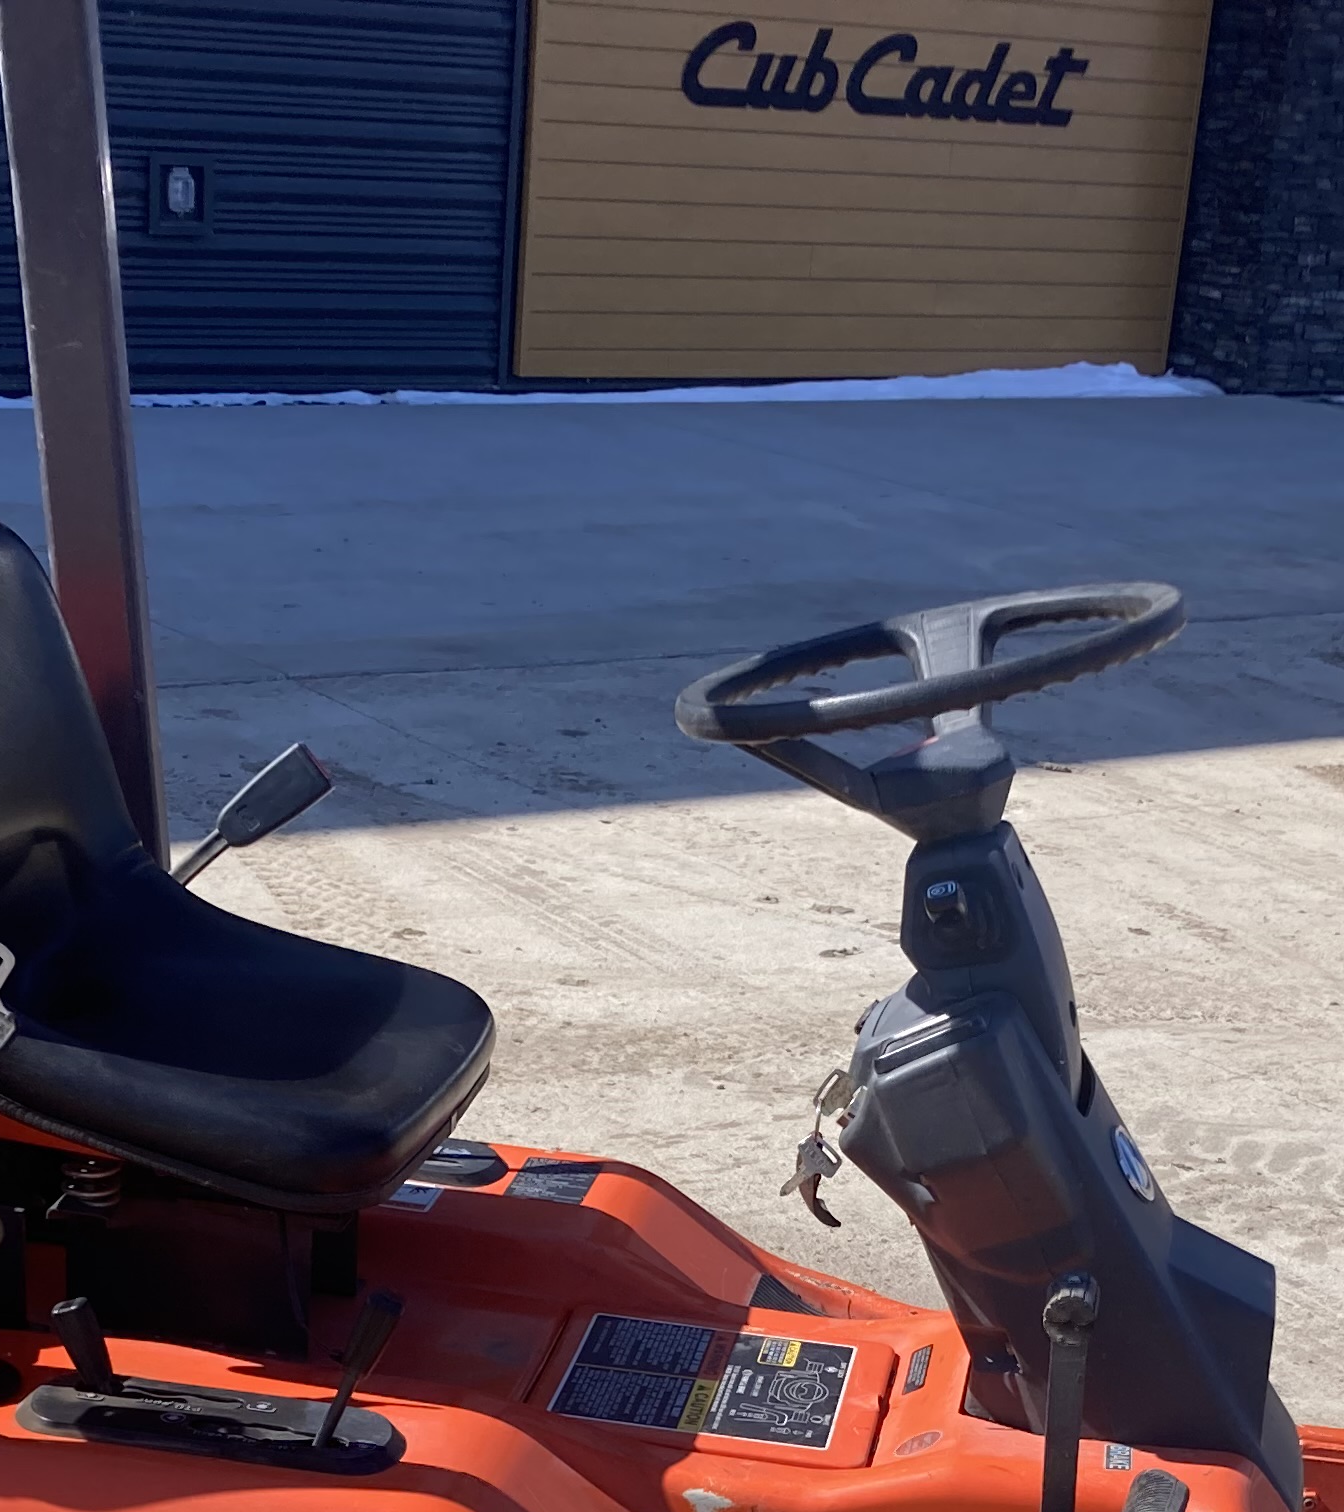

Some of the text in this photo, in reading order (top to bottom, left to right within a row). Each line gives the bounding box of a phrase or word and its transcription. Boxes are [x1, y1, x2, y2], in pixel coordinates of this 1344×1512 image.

[681, 21, 1089, 127] Cub Cadet
[686, 1391, 709, 1426] CAUTION
